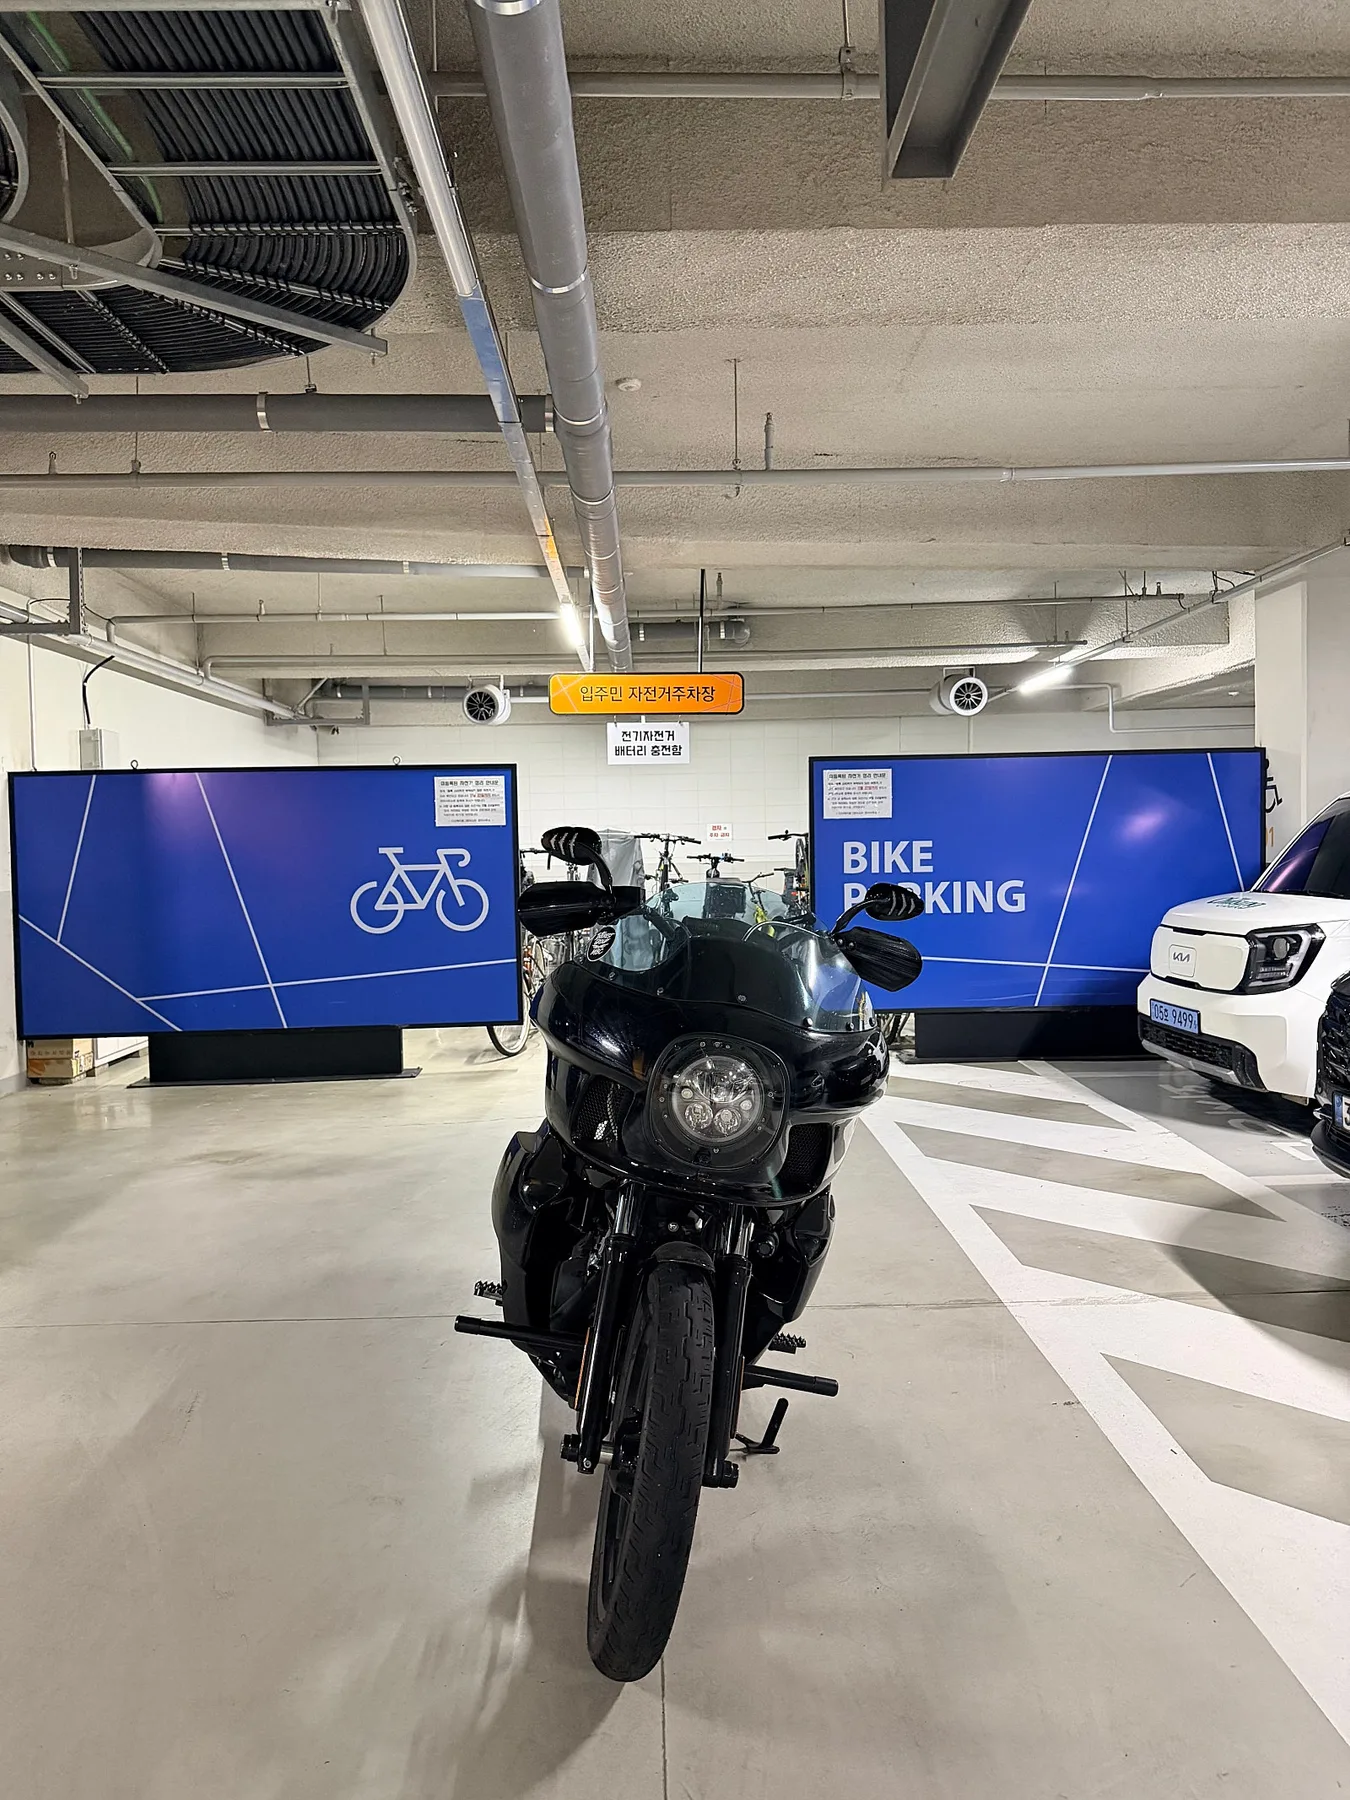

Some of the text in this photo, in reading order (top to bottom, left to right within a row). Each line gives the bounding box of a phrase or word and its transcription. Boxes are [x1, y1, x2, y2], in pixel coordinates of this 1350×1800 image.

[580, 686, 716, 702] 입주민 자전거주차장
[621, 730, 675, 742] 전기자전거
[614, 745, 683, 757] 배터리 충전함
[843, 840, 934, 874] BIKE
[843, 880, 1026, 914] PKING
[1154, 1004, 1169, 1022] 05호
[1171, 1008, 1194, 1029] 9499
